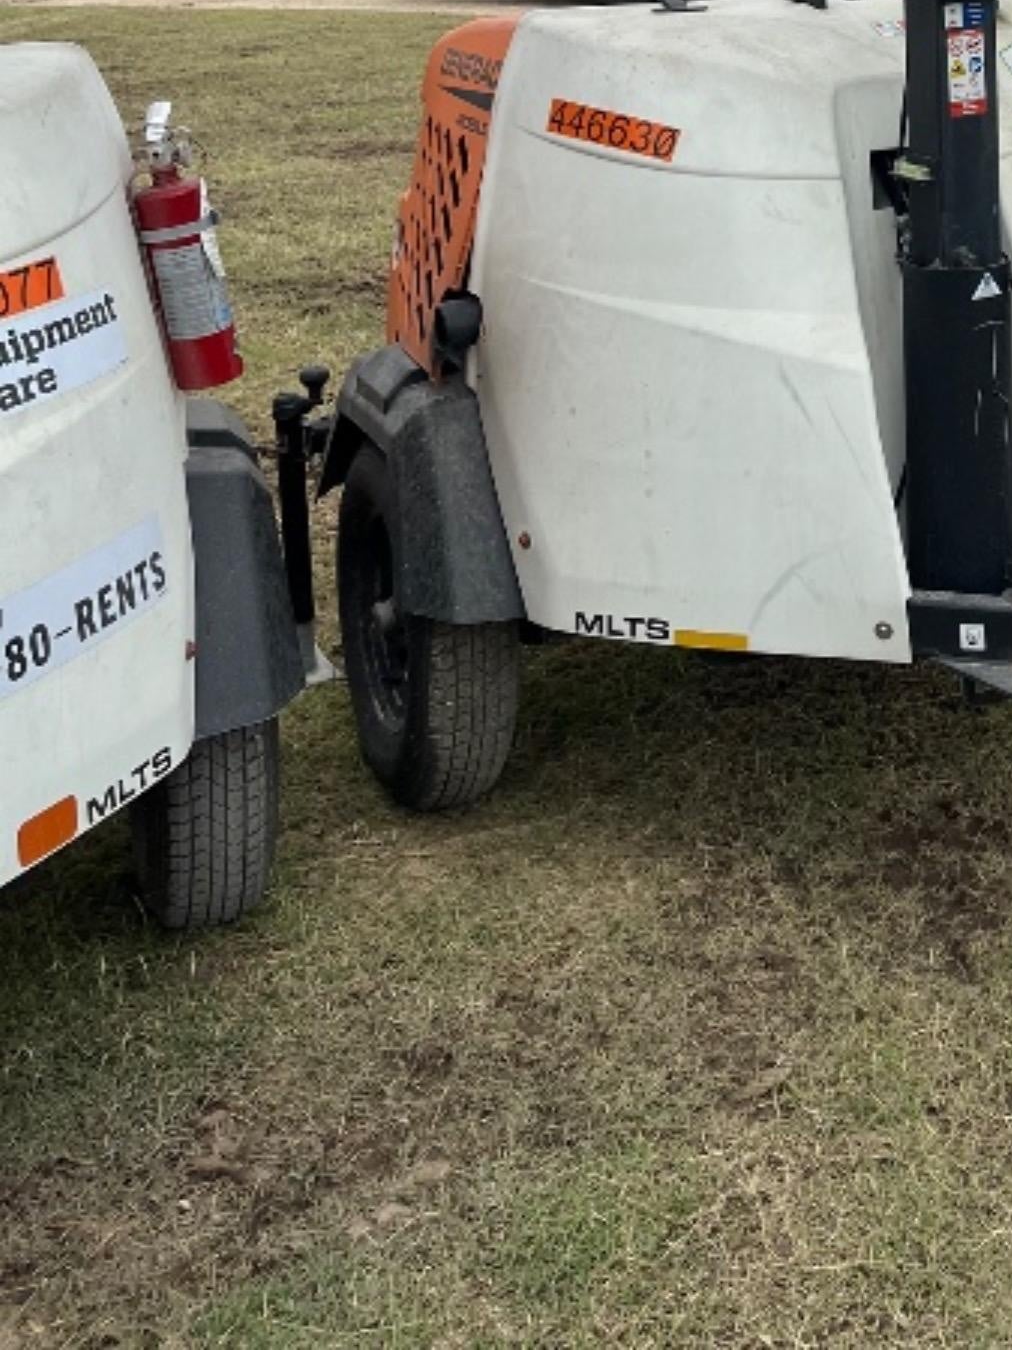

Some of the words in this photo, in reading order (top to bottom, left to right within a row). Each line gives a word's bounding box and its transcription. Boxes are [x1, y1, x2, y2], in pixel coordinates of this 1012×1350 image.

[550, 101, 677, 159] 446630
[575, 601, 670, 640] MLTS
[86, 746, 171, 825] MLTS
